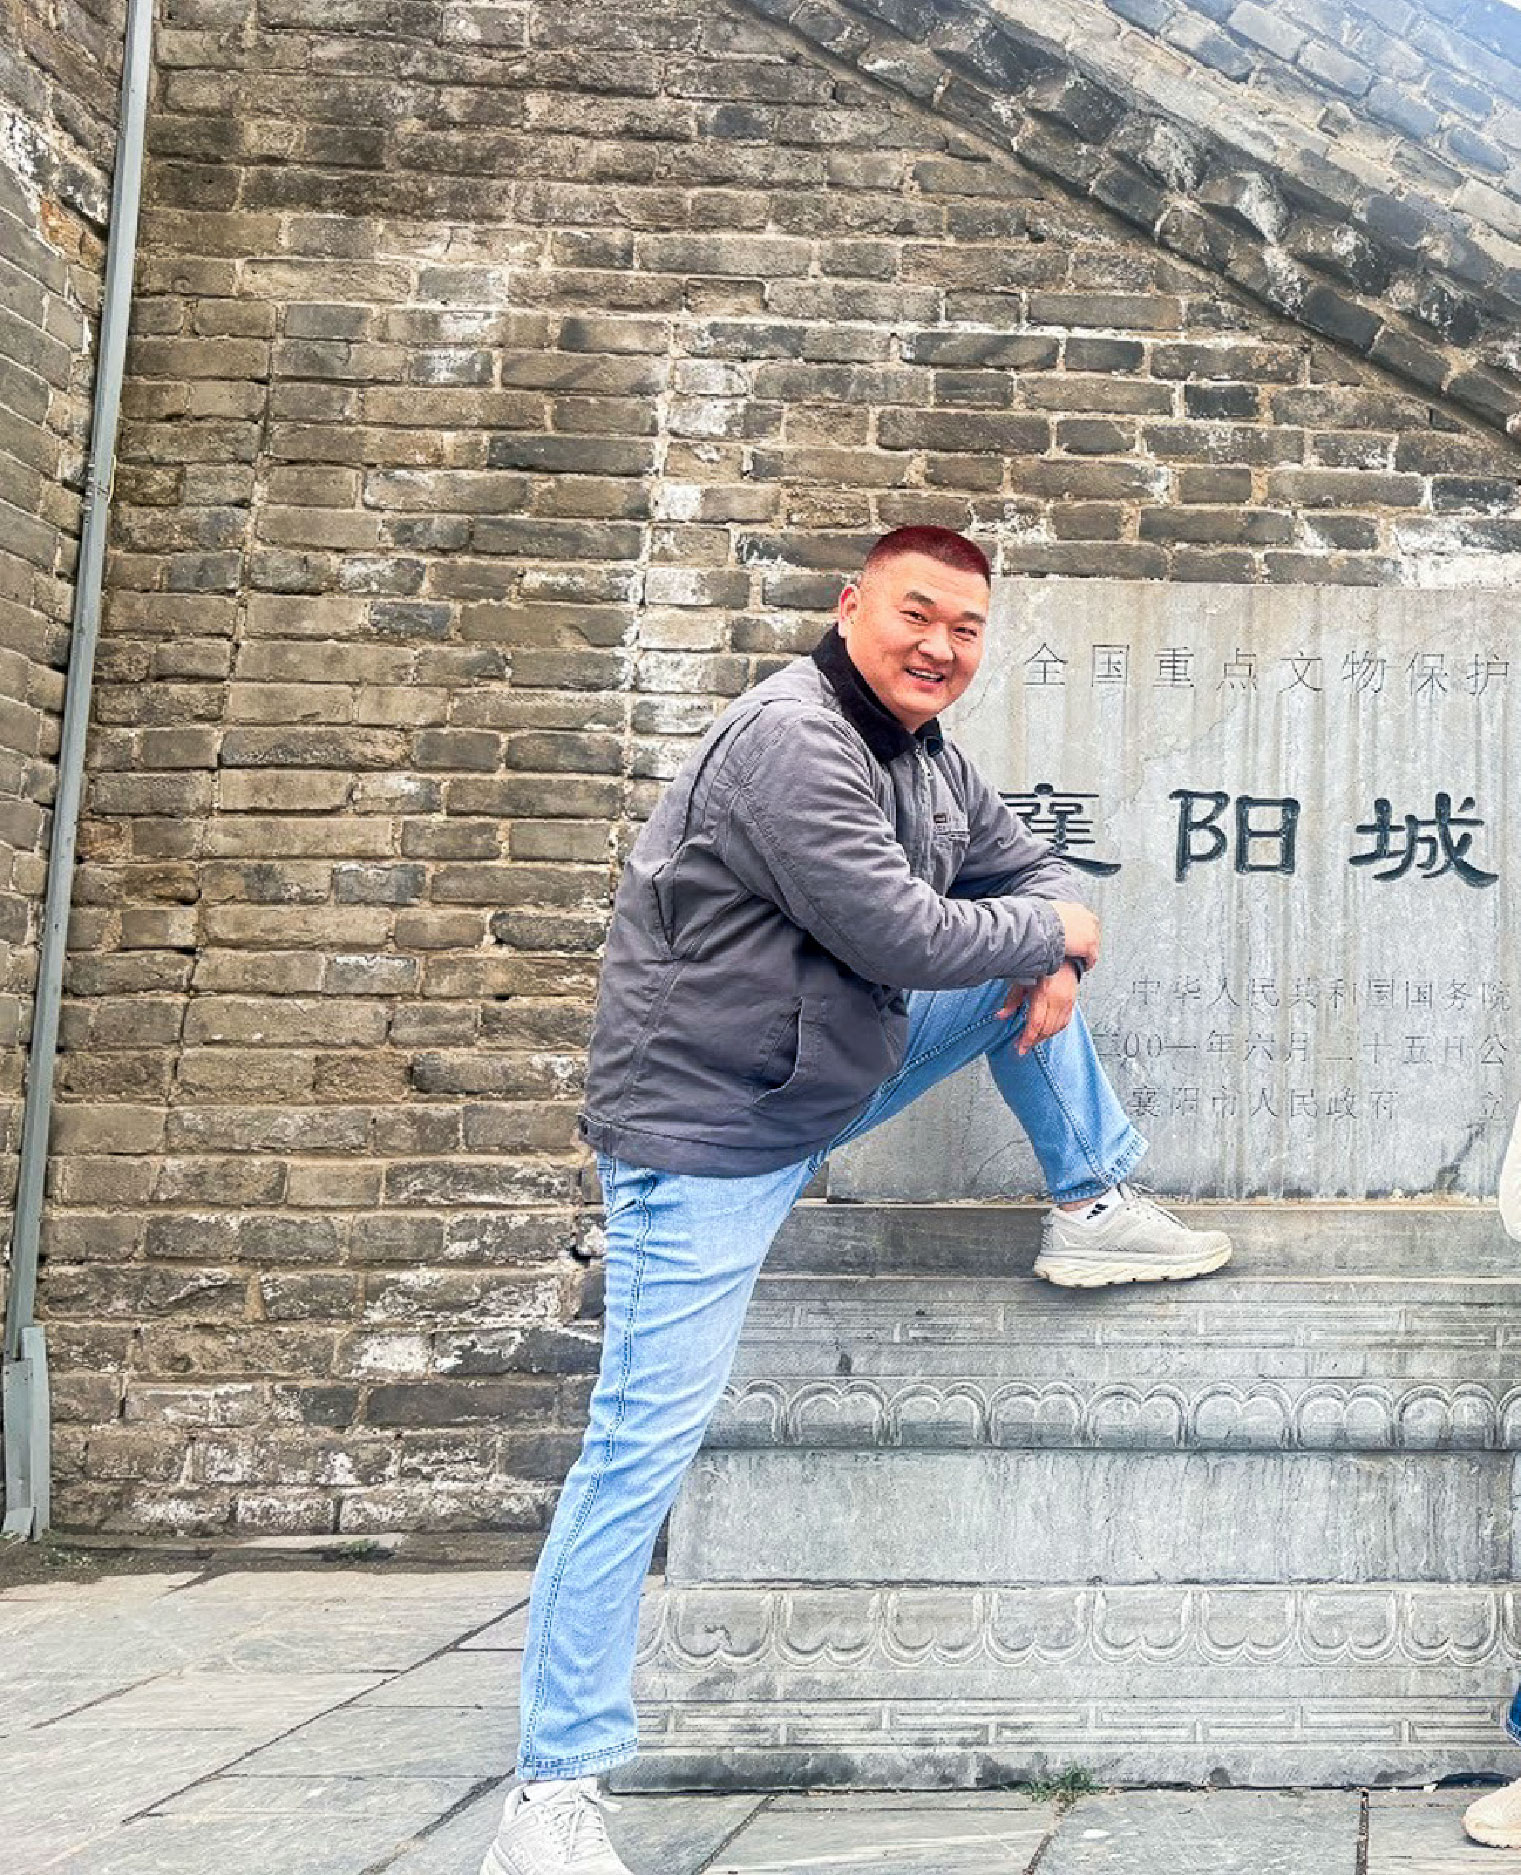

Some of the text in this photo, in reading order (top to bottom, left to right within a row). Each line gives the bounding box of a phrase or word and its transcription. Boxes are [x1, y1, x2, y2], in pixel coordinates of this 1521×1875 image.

[1130, 974, 1512, 1012] 中华人民共和国国务院
[1127, 1085, 1400, 1121] 襄阳市人民政府
